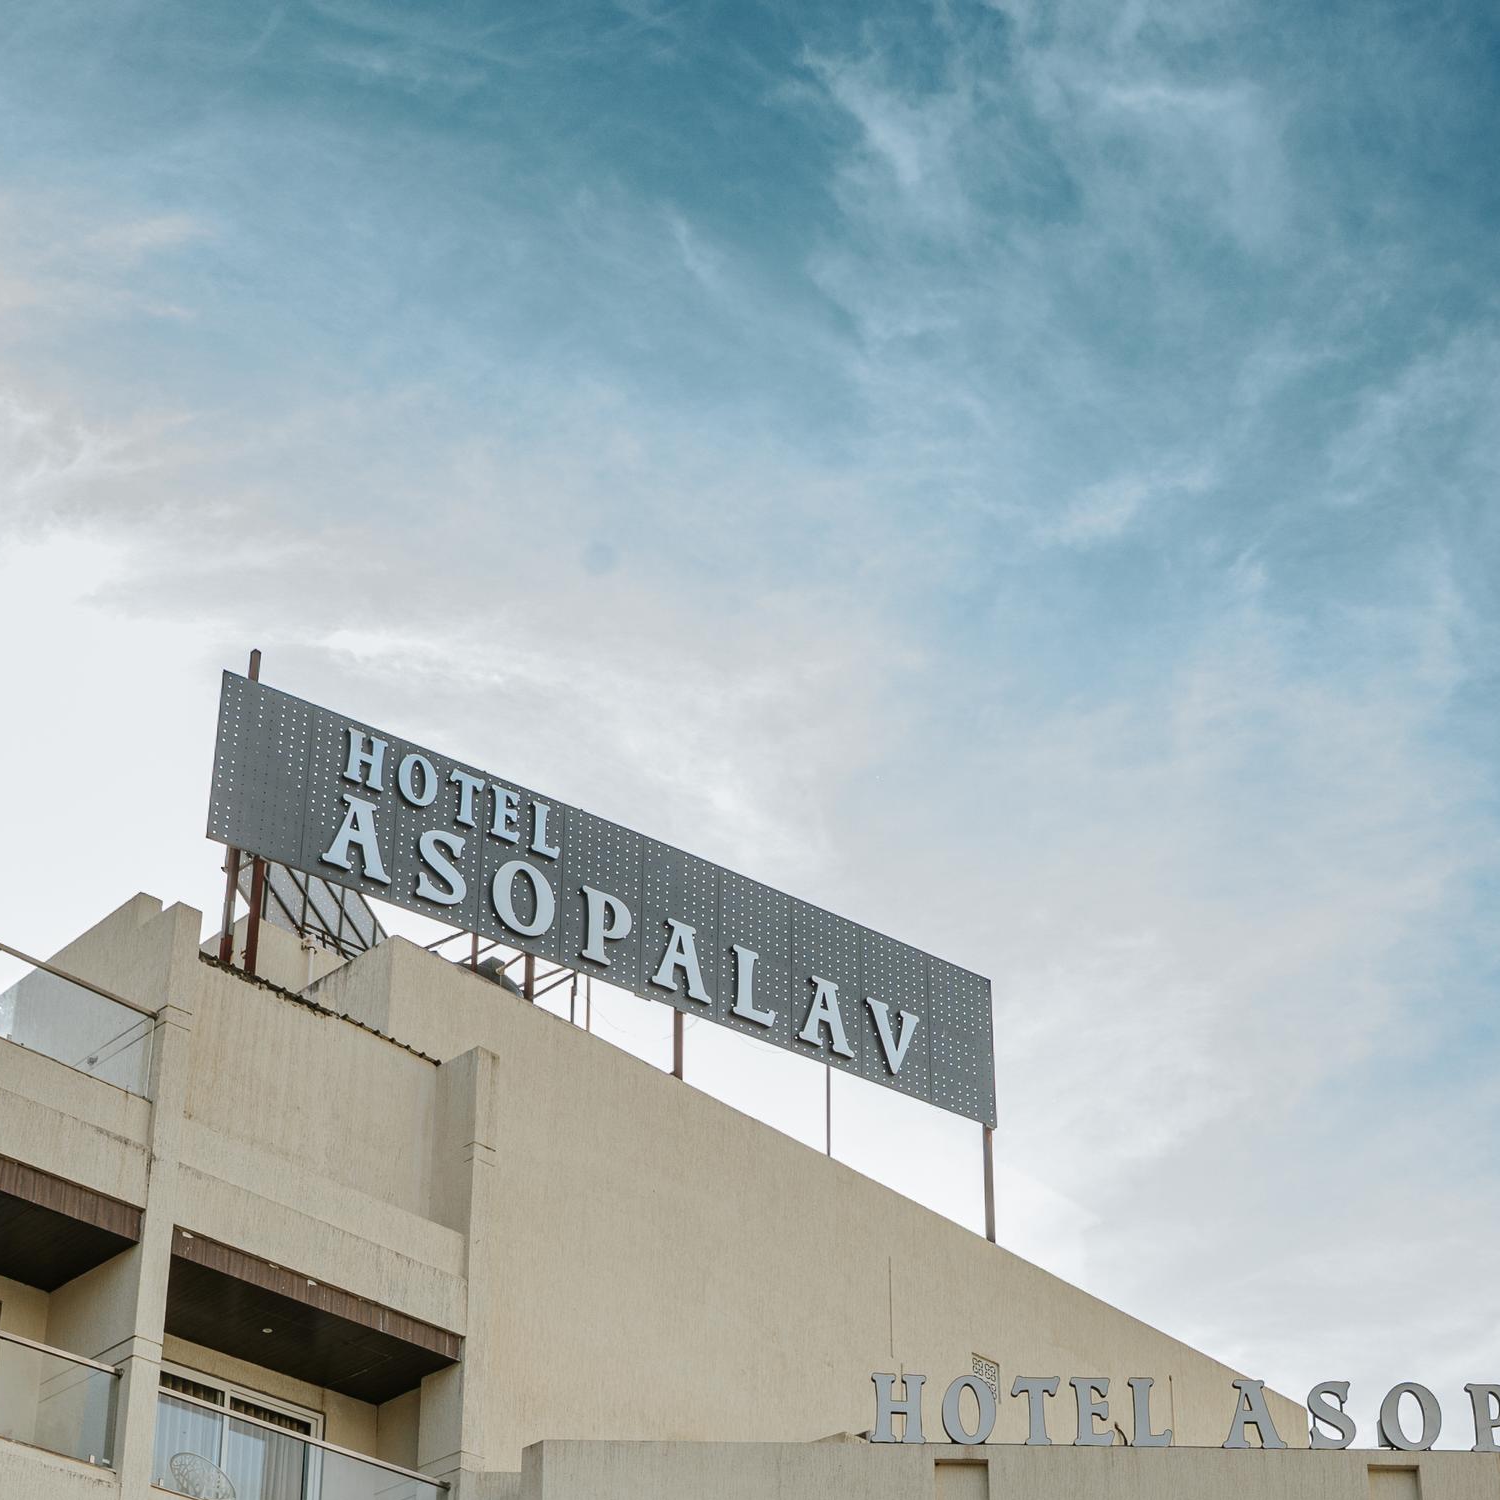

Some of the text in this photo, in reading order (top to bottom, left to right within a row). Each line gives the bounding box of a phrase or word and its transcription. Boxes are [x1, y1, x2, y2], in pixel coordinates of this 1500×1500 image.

[342, 726, 562, 861] HOTEL
[320, 792, 920, 1076] ASOPALAV
[868, 1371, 1174, 1448] HOTEL
